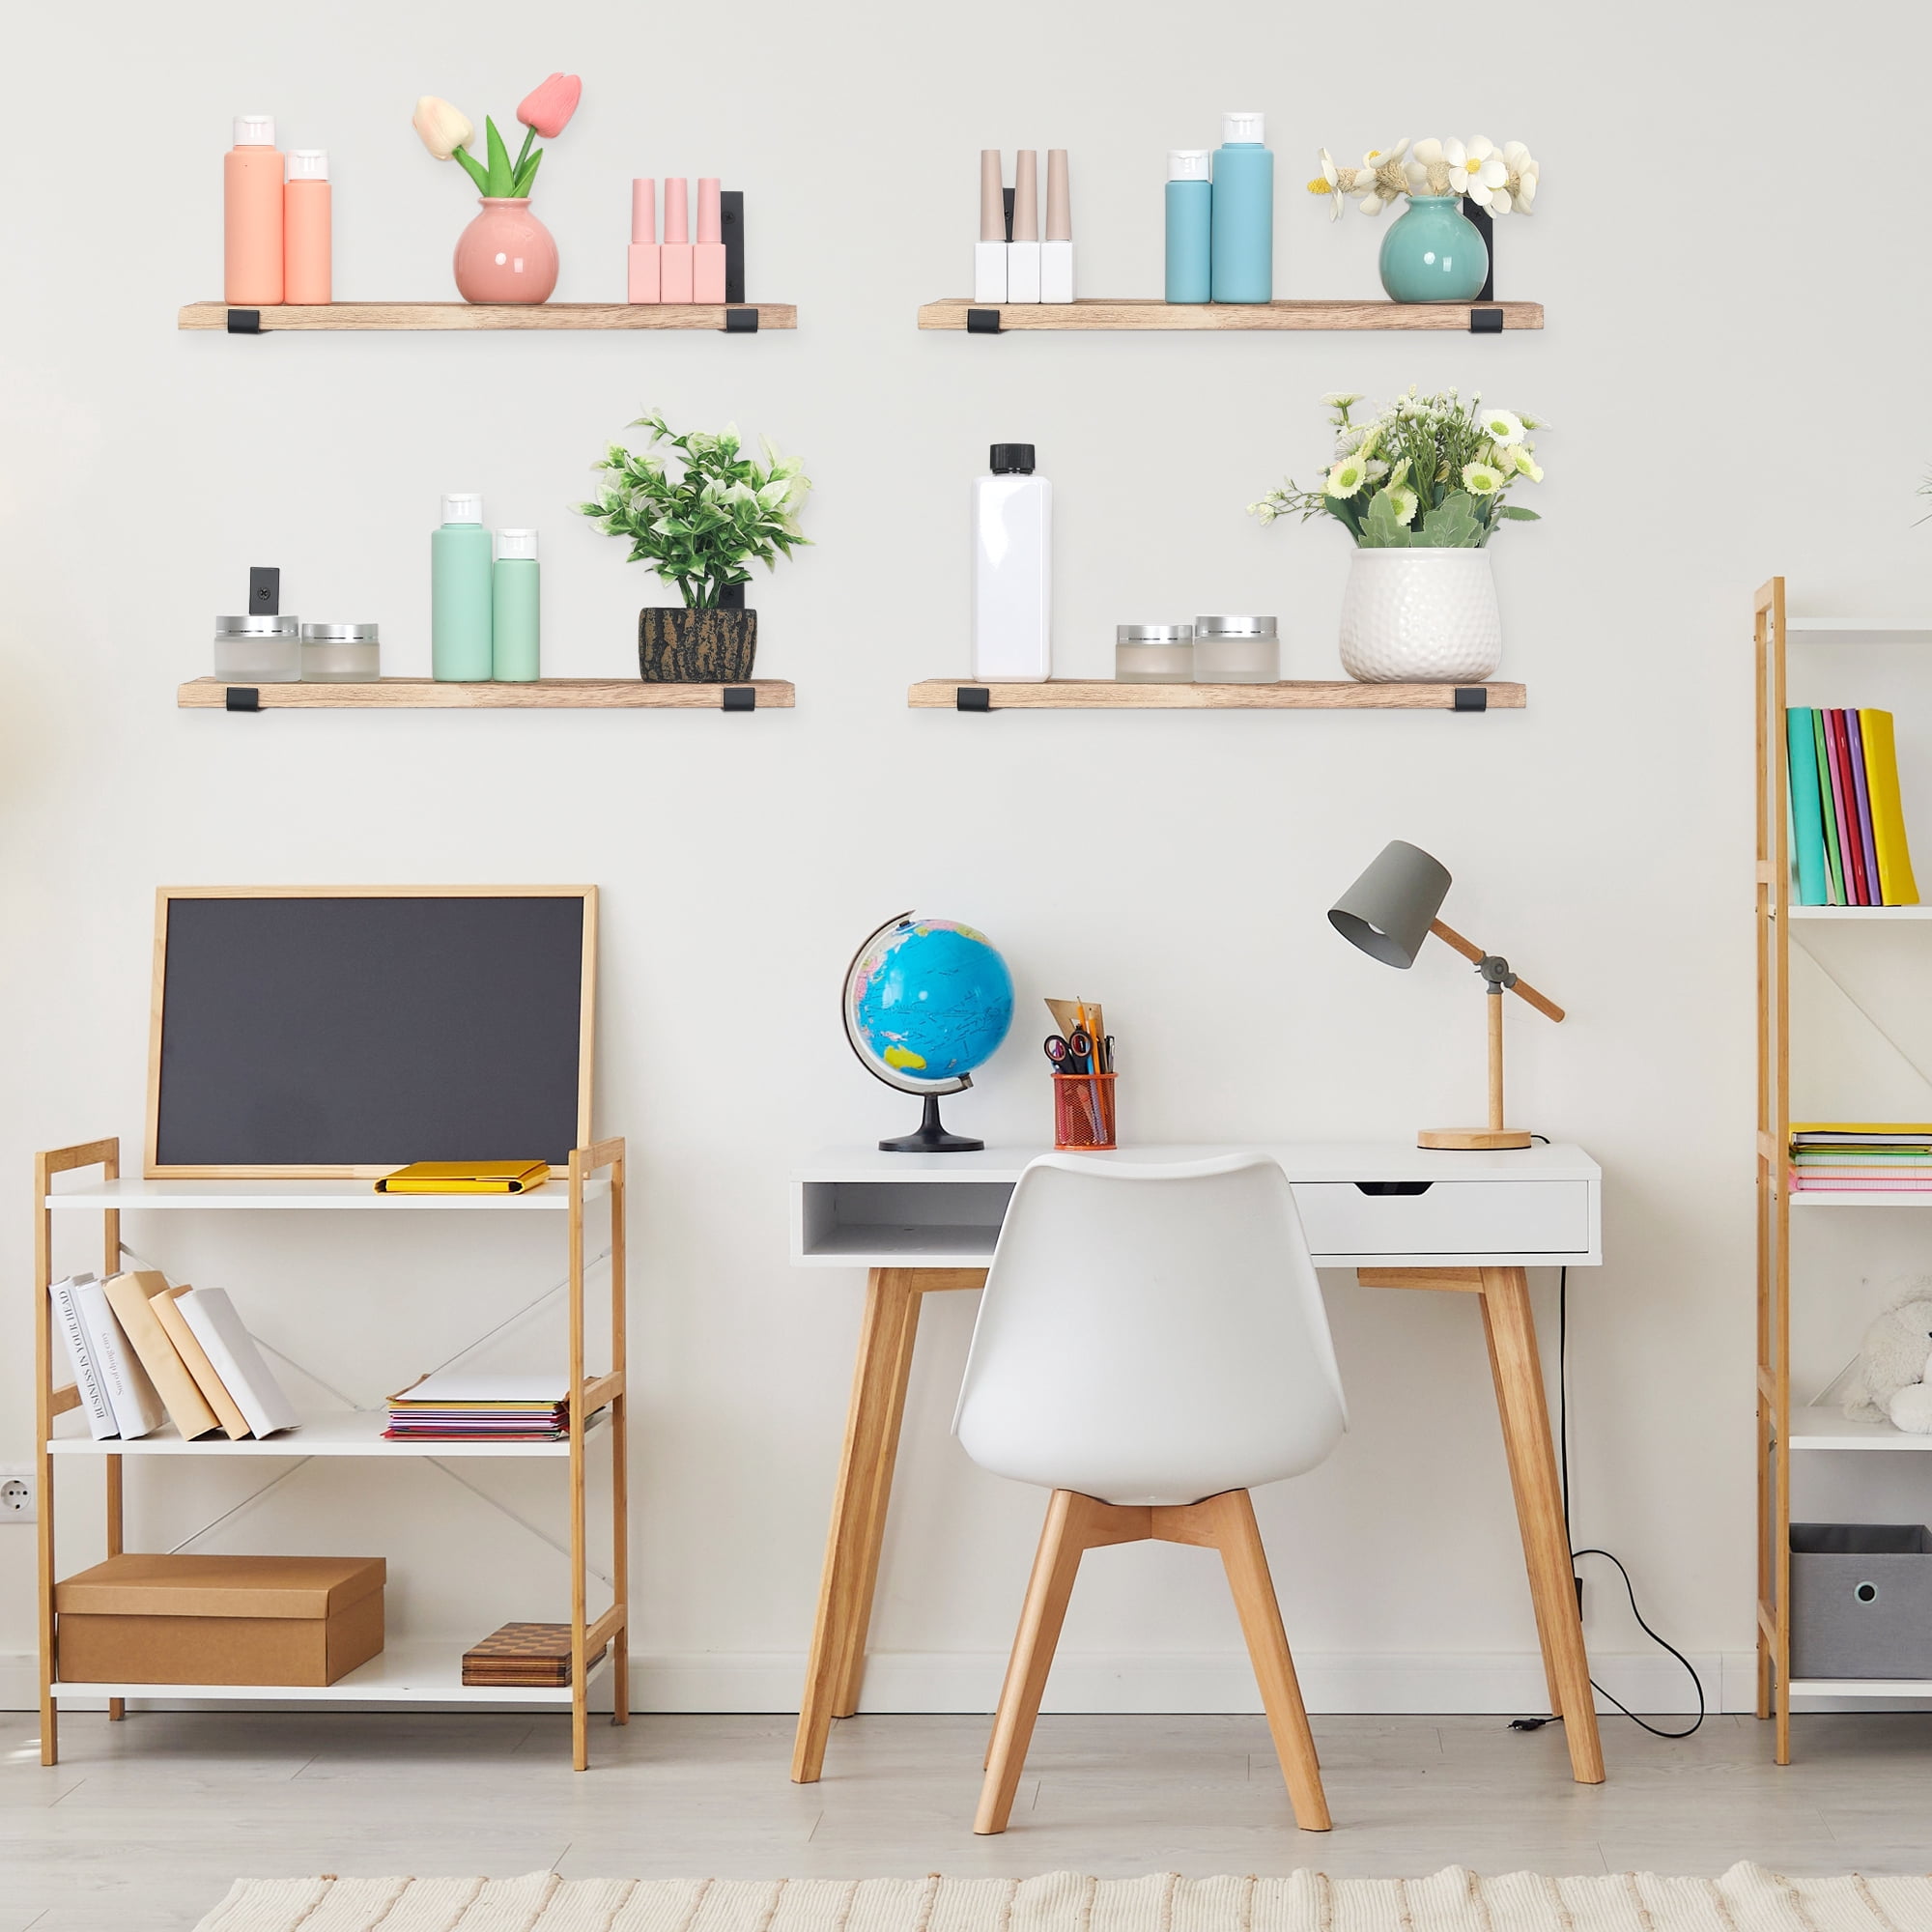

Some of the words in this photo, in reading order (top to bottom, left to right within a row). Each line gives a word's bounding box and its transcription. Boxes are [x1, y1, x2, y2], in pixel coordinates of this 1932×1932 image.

[59, 1290, 75, 1321] HEAD
[69, 1323, 85, 1353] YOUR
[78, 1354, 90, 1368] IN
[83, 1368, 105, 1419] BUSINESS
